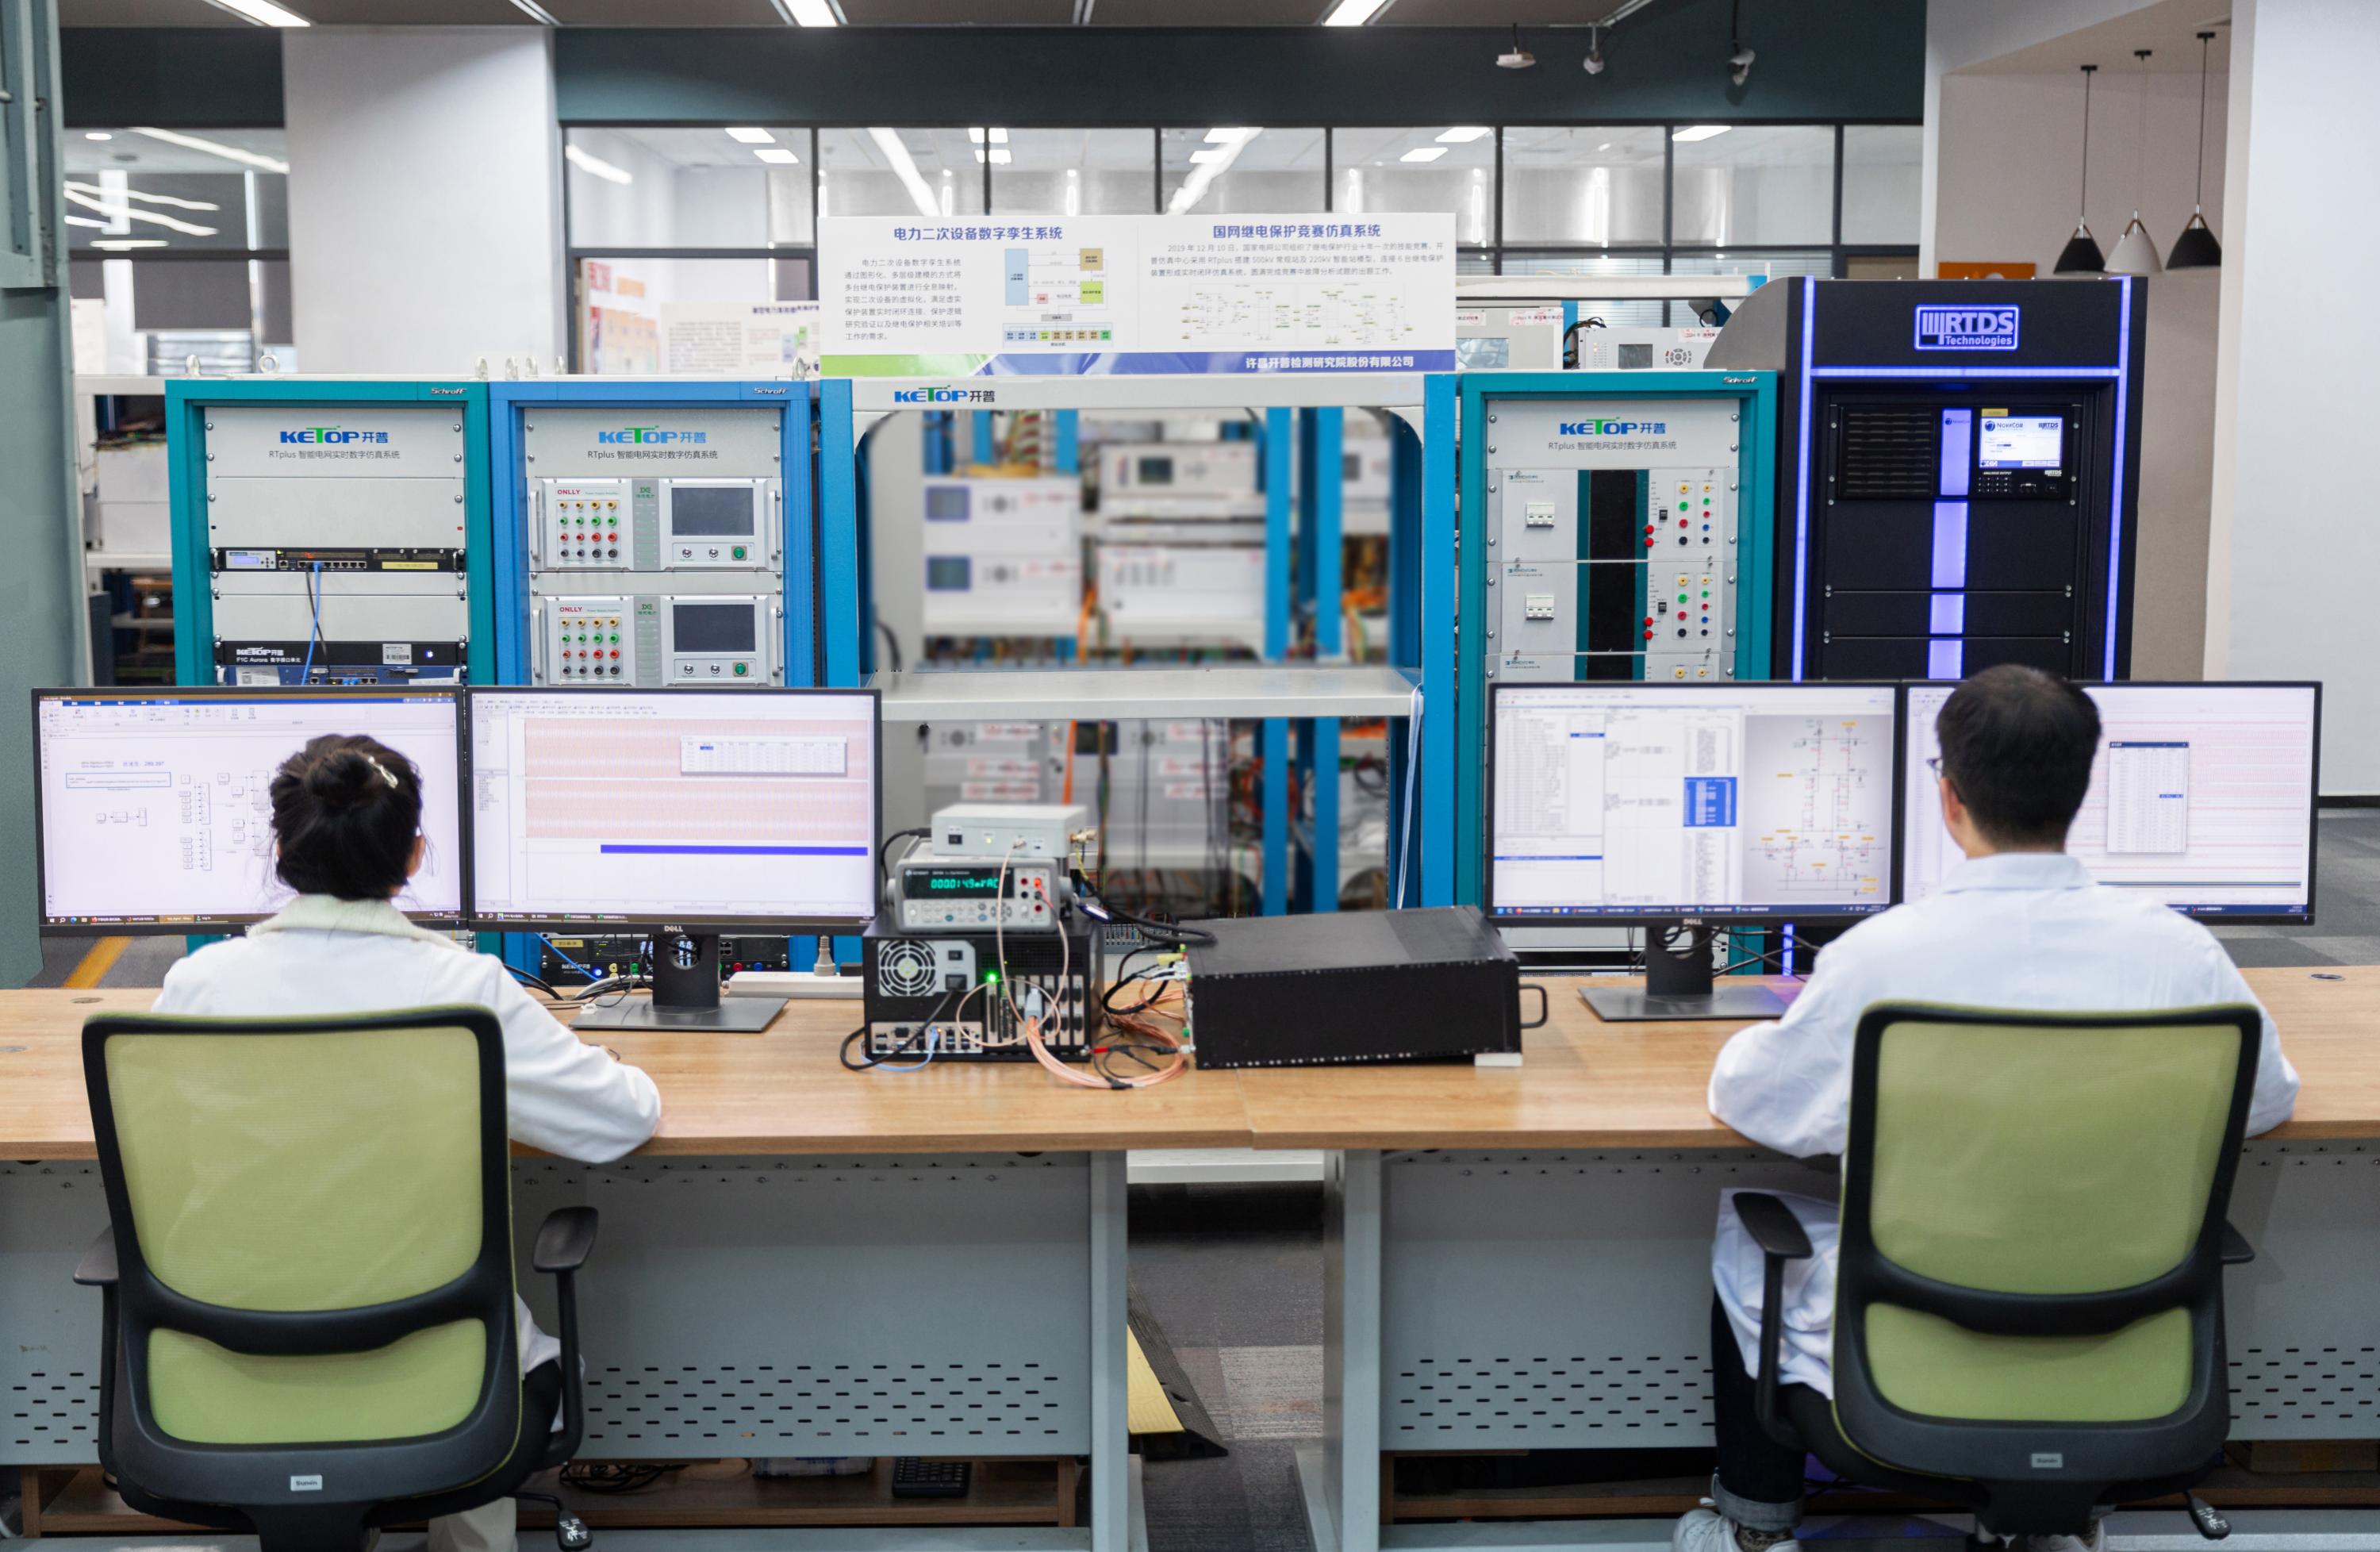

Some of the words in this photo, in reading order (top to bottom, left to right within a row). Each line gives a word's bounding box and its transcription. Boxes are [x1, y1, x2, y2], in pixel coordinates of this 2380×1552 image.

[893, 226, 1063, 241] 电力二次设备数字孪生系统
[1212, 224, 1381, 239] 国网继电保护竞赛仿真系统
[1944, 312, 2014, 333] RTDS
[1944, 336, 2013, 347] Technologies
[1246, 355, 1414, 369] 许昌开普检测研究院股份有限公司
[894, 384, 968, 402] KETOP
[969, 389, 996, 402] 开普
[1560, 417, 1638, 435] KETOP
[1640, 423, 1666, 434] 开普
[280, 425, 359, 444] KETOP
[362, 431, 389, 444] 开普
[598, 425, 678, 444] KETOP
[679, 431, 706, 444] 开普
[1548, 441, 1575, 451] RTplus
[1577, 441, 1677, 450] 智能电网实时数字仿真系统
[268, 450, 297, 459] RTplus
[298, 450, 400, 459] 智能电网实时数字仿真系统
[587, 450, 615, 460] RTplus
[616, 450, 718, 459] 智能电网实时数字仿真系统
